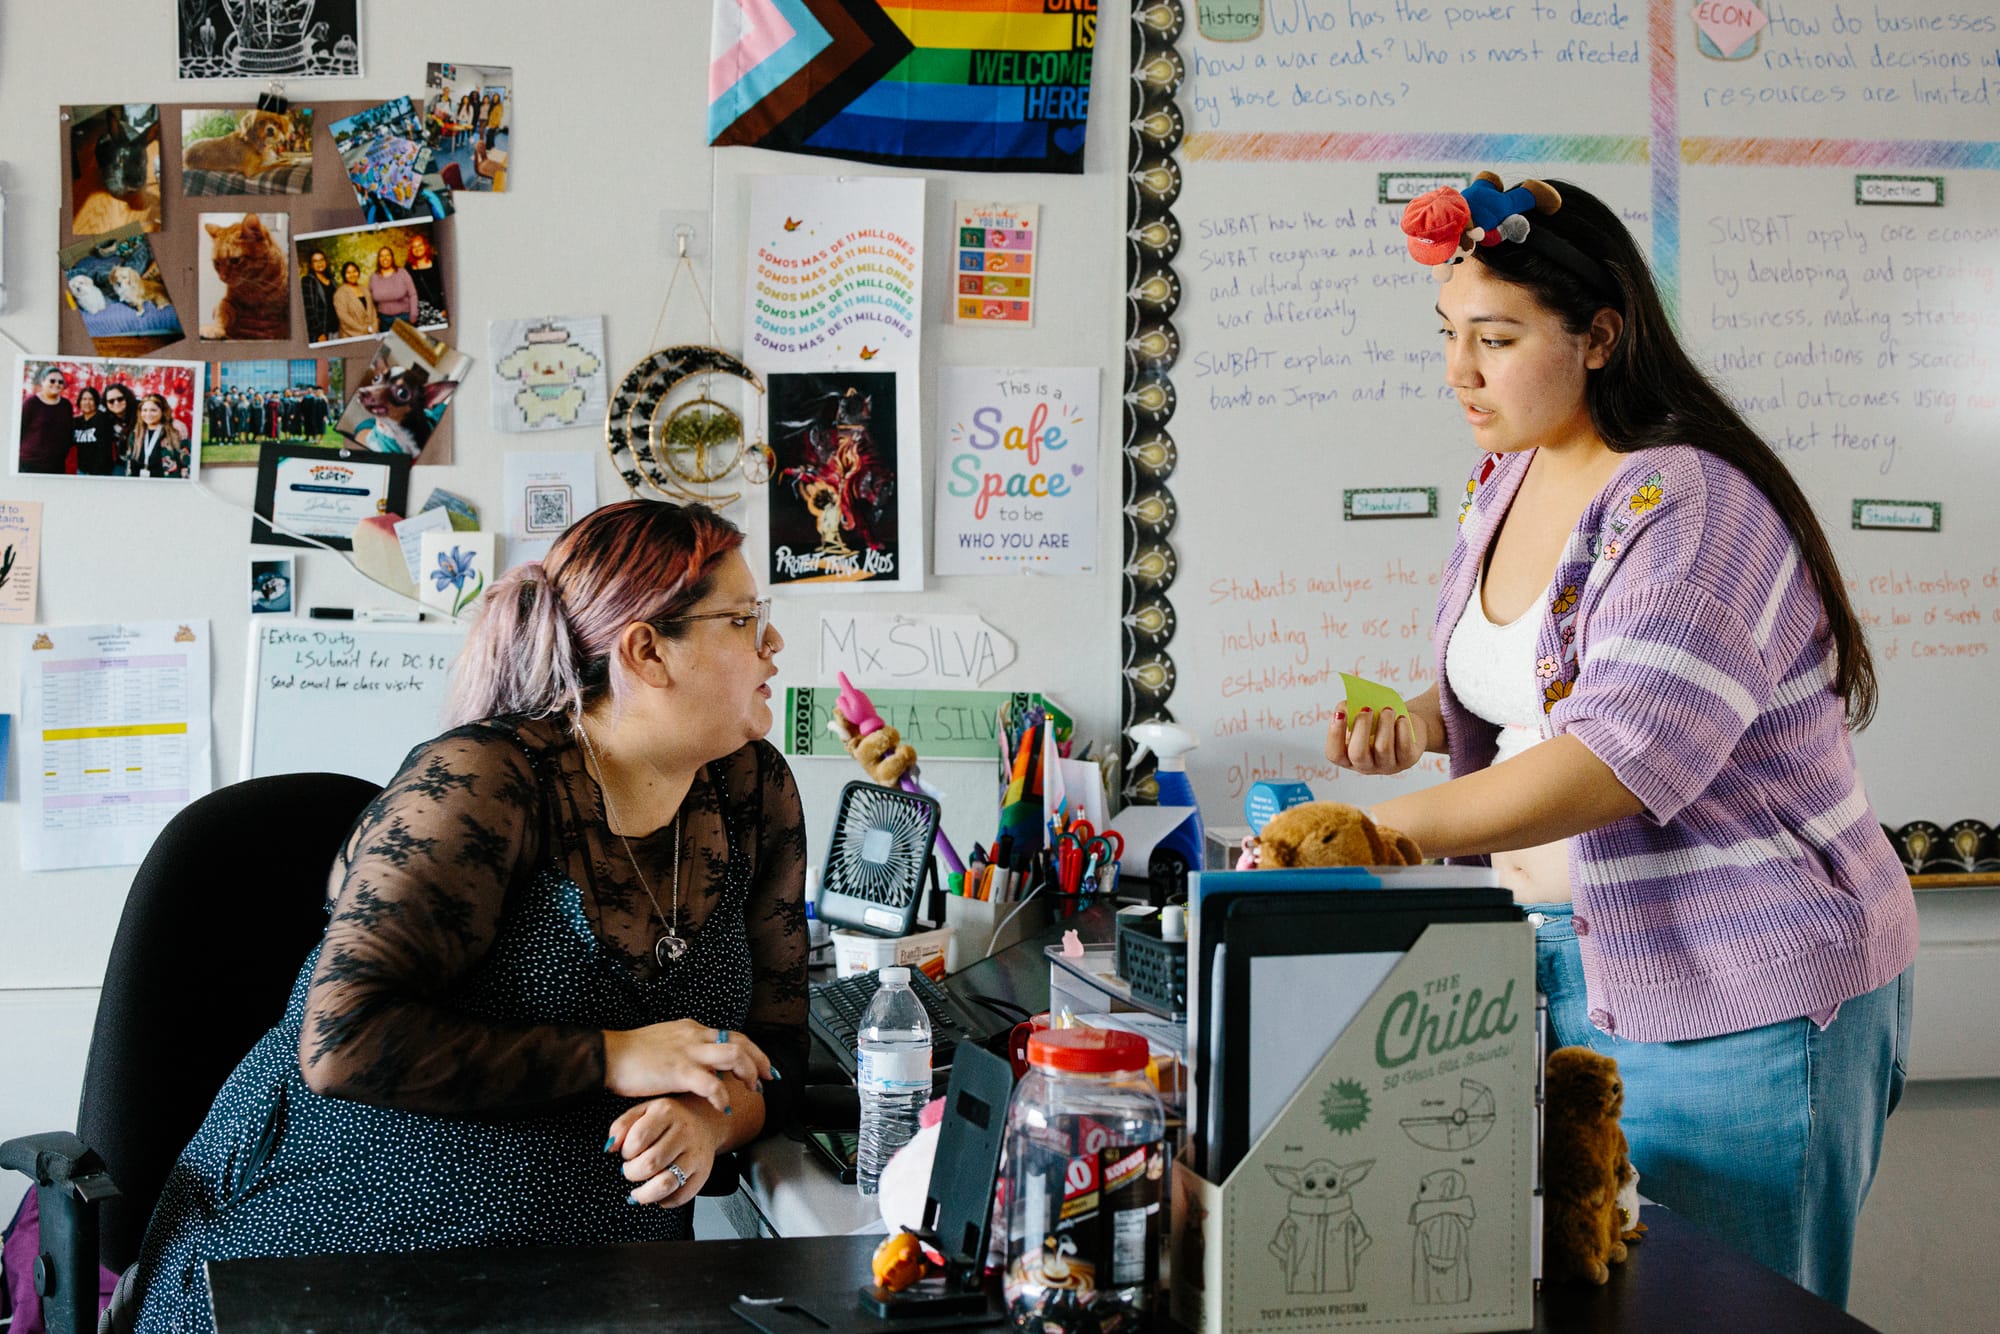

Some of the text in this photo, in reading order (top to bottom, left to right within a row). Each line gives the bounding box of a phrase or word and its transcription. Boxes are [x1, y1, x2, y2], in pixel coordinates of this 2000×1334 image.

[1075, 13, 1097, 48] IS
[1198, 4, 1260, 28] History
[1269, 0, 1630, 36] Who has the power to decide
[1698, 1, 1752, 28] ECON
[1767, 3, 1998, 36] How do businesses
[975, 51, 1092, 85] WELCOME
[1193, 37, 1640, 76] how a war ends? Who is most affected
[1763, 42, 1858, 69] rational
[1871, 43, 1971, 69] decisions
[1027, 86, 1089, 119] HERE
[1193, 81, 1411, 127] by those decisions?
[1703, 82, 1847, 108] resources
[1863, 86, 1901, 102] are
[1198, 214, 1259, 240] SWBAT
[1303, 212, 1327, 230] the
[1335, 208, 1356, 230] end
[1364, 208, 1378, 229] of
[1706, 214, 1796, 246] SWBAT
[1807, 219, 1867, 254] apply
[757, 245, 916, 285] SOMOS MAS DE 11 MILLONES
[758, 228, 916, 268] SOMOS MAS DE 11 MILLONES
[1198, 246, 1259, 273] SWBAT
[1348, 240, 1376, 258] and
[756, 263, 915, 302] SOMOS MAS DE 11 MILLONES
[1210, 271, 1435, 303] and cultural groups experie
[1712, 255, 1740, 298] by
[1748, 257, 1850, 300] developing
[1863, 255, 1894, 282] and
[755, 278, 914, 320] SOMOS MAS DE 11 MILLONES
[755, 294, 914, 336] SOMOS MAS DE 11 MILLONES
[754, 312, 913, 353] SOMOS MAS DE 11 MILLONES
[1216, 298, 1357, 337] war differently
[1824, 297, 1890, 344] making
[1193, 338, 1395, 378] SWBAT explain the
[1775, 340, 1865, 368] conditions
[1876, 336, 1900, 369] of
[997, 379, 1063, 401] This is a
[1257, 392, 1277, 406] on
[1282, 385, 1338, 411] Japan
[1351, 379, 1386, 402] and
[1399, 381, 1425, 400] the
[969, 402, 1068, 466] Safe
[947, 453, 1072, 520] Space
[999, 505, 1043, 521] to be
[959, 533, 1070, 548] WHO YOU ARE
[1208, 570, 1298, 606] Students
[1386, 558, 1418, 586] the
[1868, 567, 1971, 598] relationship
[269, 629, 355, 655] Extra Duty
[889, 622, 998, 678] SILVA
[1220, 618, 1310, 666] including
[1321, 611, 1350, 639] the
[1362, 618, 1390, 638] use
[1401, 607, 1420, 639] of
[370, 650, 390, 669] for
[1375, 661, 1404, 682] the
[935, 706, 1000, 741] SILV
[1213, 709, 1284, 738] and the
[1227, 752, 1284, 798] global
[1424, 974, 1461, 996] THE
[1375, 978, 1520, 1069] Child
